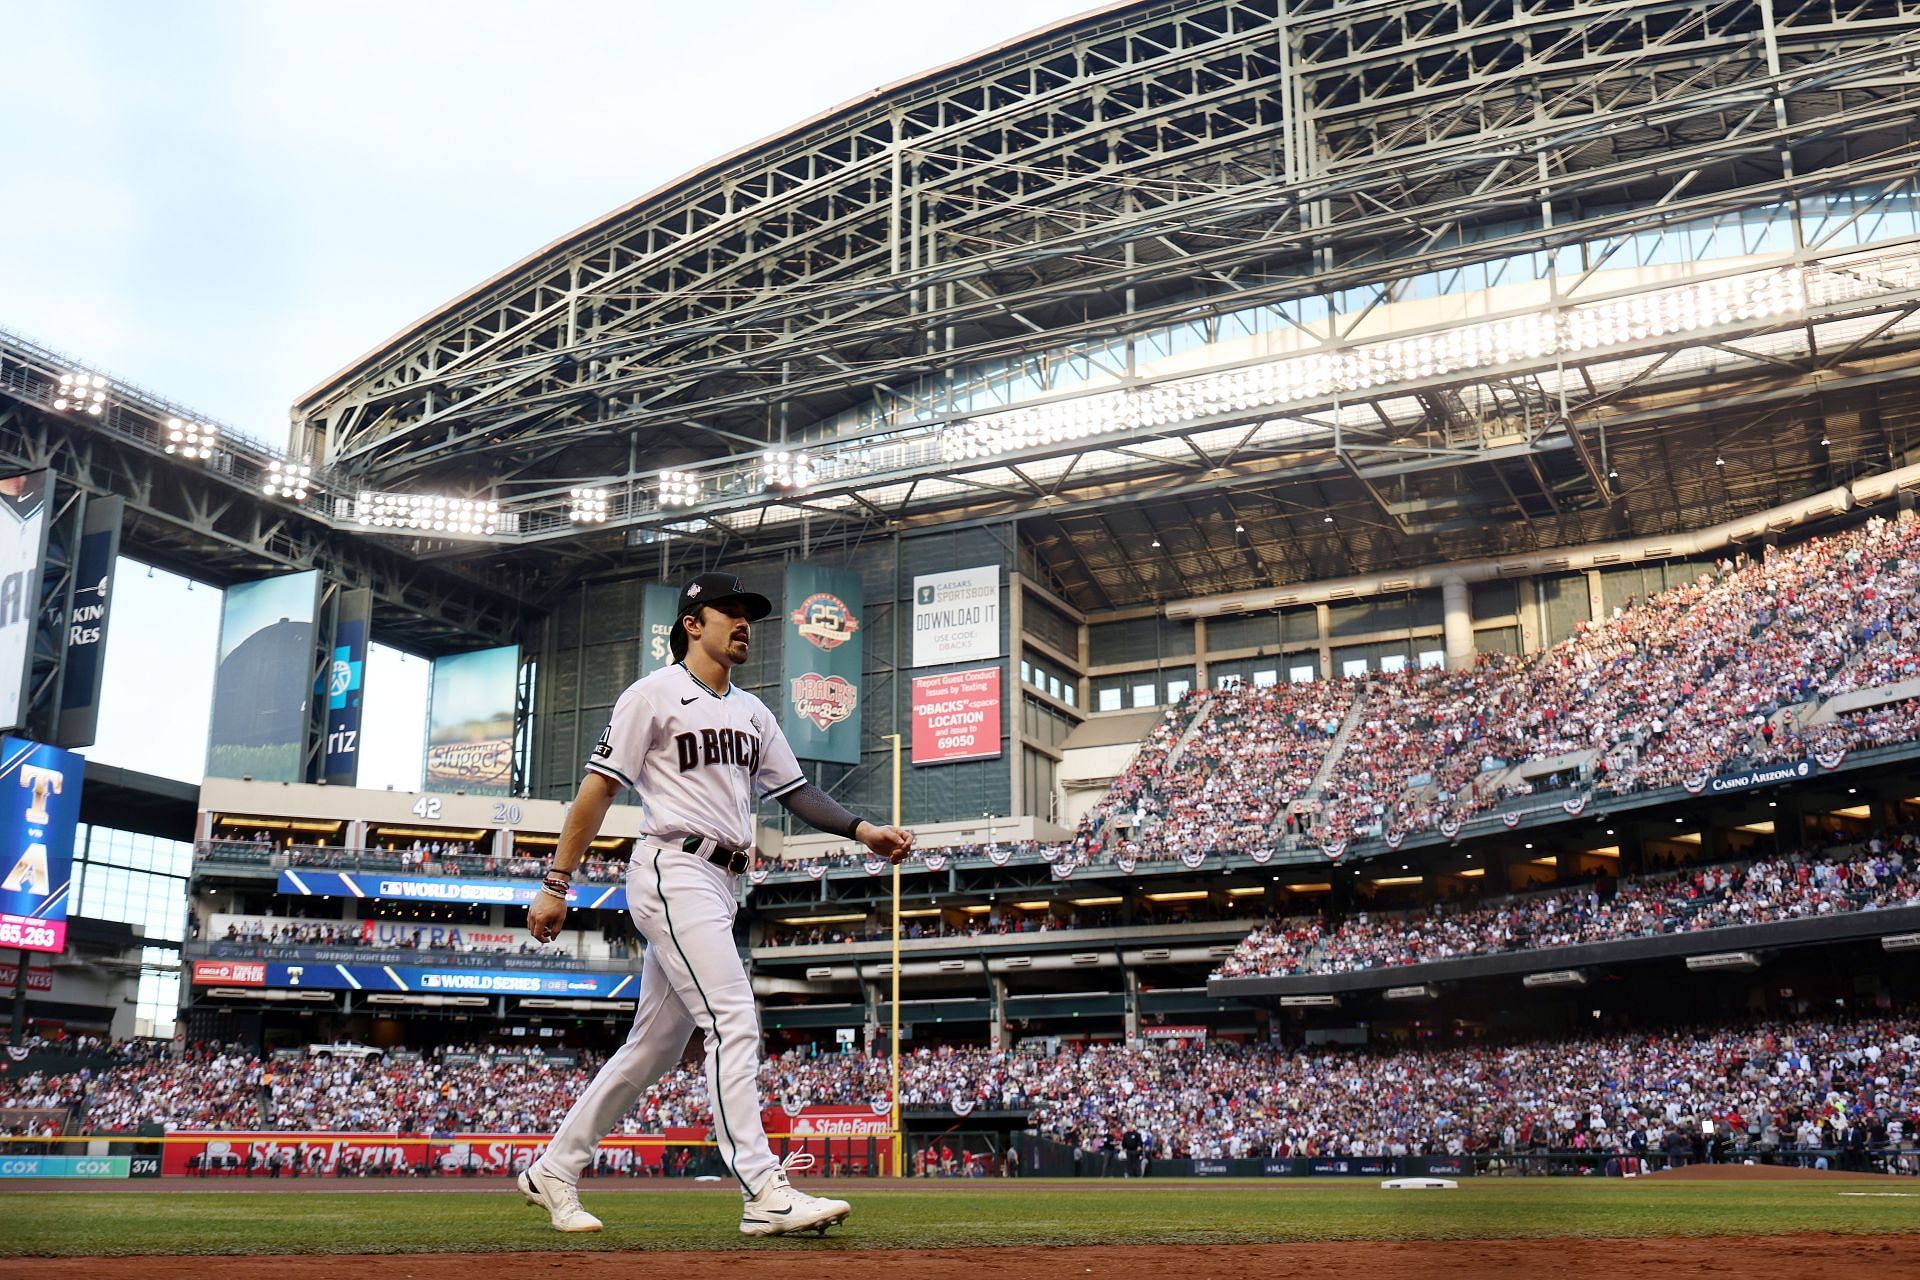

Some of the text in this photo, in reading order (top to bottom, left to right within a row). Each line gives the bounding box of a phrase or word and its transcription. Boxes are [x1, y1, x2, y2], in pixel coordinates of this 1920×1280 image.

[937, 581, 973, 591] CAESARS
[937, 586, 996, 602] SPORTSBOOK
[811, 604, 839, 630] 25
[917, 605, 996, 631] DOWNLOAD IT
[934, 634, 949, 642] USE
[939, 641, 972, 651] DBACKS
[917, 671, 996, 688] Report Guest Conduct
[926, 683, 988, 697] Issues by Texting
[797, 700, 850, 719] Give Back
[928, 711, 984, 728] LOCATION
[935, 728, 949, 736] and
[950, 726, 968, 735] issue
[938, 734, 974, 749] 69050
[431, 746, 504, 776] Slugger
[1713, 768, 1796, 791] CASINO ARIZONA
[20, 764, 63, 825] T
[412, 797, 441, 819] 42
[492, 801, 522, 824] 20
[1, 843, 49, 896] A
[402, 881, 460, 898] WORLD
[460, 885, 514, 901] SERIES
[380, 924, 514, 945] ULTRA TERRACE
[315, 951, 353, 961] SUPERIOR
[355, 953, 379, 962] LIGHT
[505, 958, 541, 968] SUPERIOR
[441, 974, 492, 989] WORLD
[492, 976, 541, 991] SERIES
[2, 1161, 111, 1174] COX COX
[132, 1160, 157, 1173] 374
